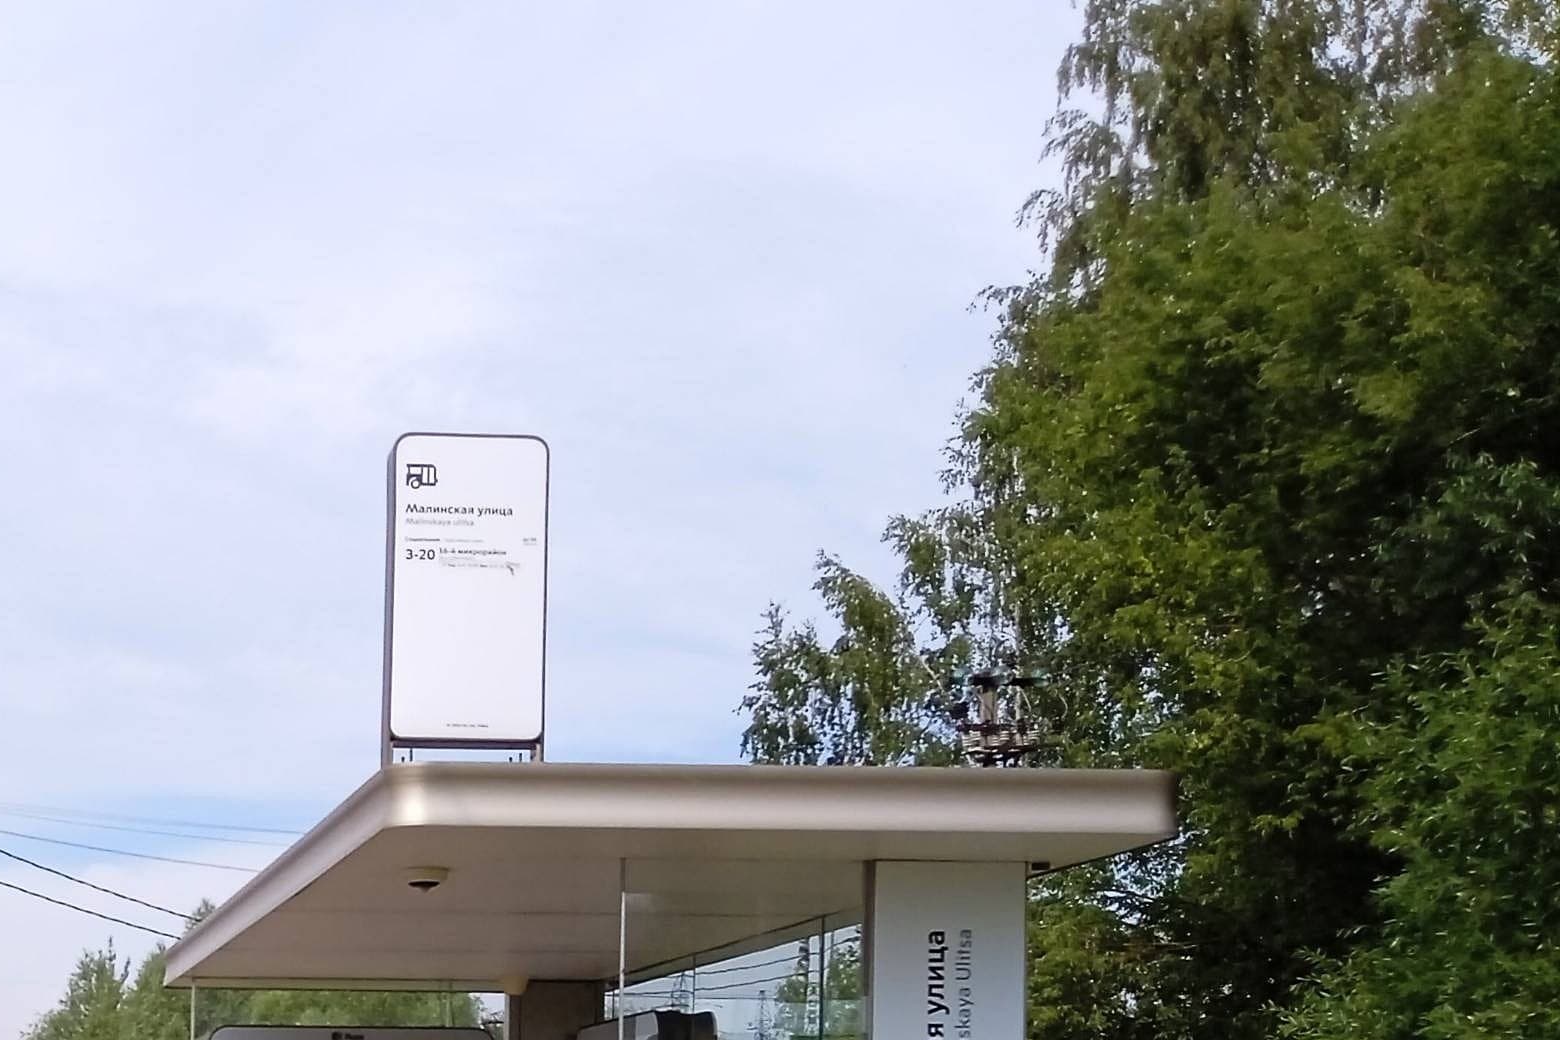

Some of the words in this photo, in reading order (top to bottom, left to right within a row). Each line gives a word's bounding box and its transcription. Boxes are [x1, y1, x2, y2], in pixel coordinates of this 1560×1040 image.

[405, 503, 474, 515] Малинская
[477, 506, 513, 518] улица
[927, 930, 951, 1015] улица
[954, 929, 973, 981] Ulitsa
